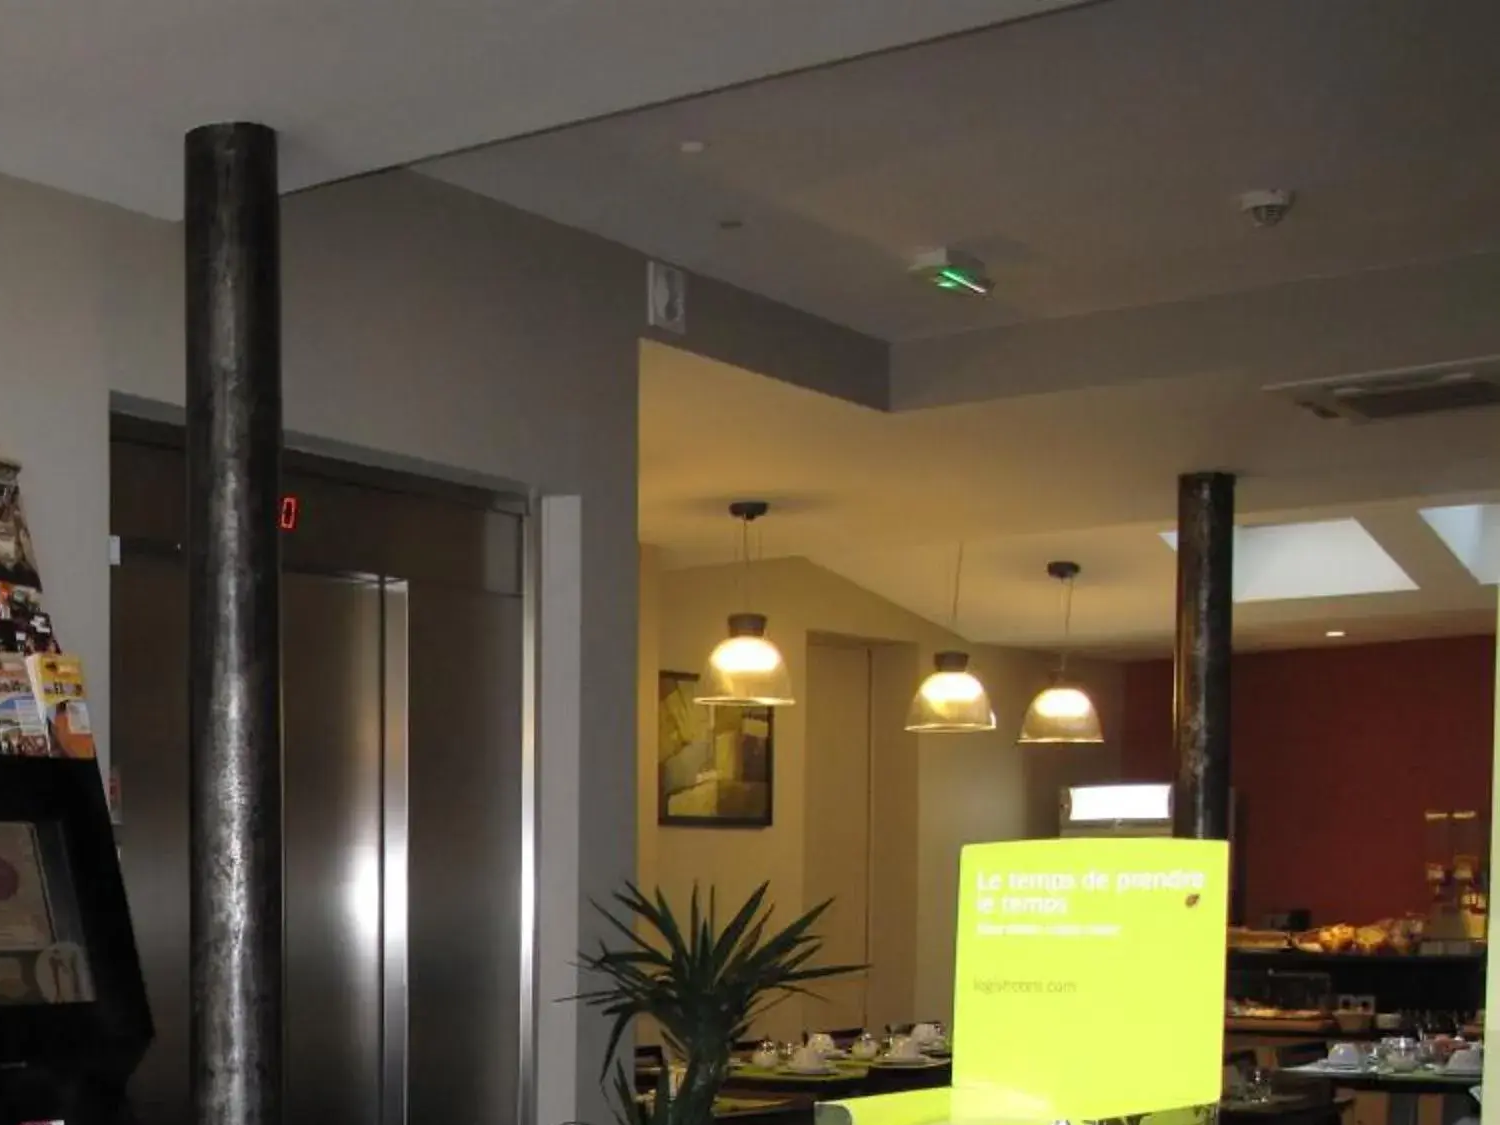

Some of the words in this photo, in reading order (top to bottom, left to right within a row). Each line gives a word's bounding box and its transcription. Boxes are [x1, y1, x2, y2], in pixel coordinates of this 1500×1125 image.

[280, 497, 296, 529] 0
[976, 870, 1001, 891] Le
[1008, 870, 1074, 894] temps
[1082, 869, 1109, 891] de
[1116, 868, 1206, 894] prendre
